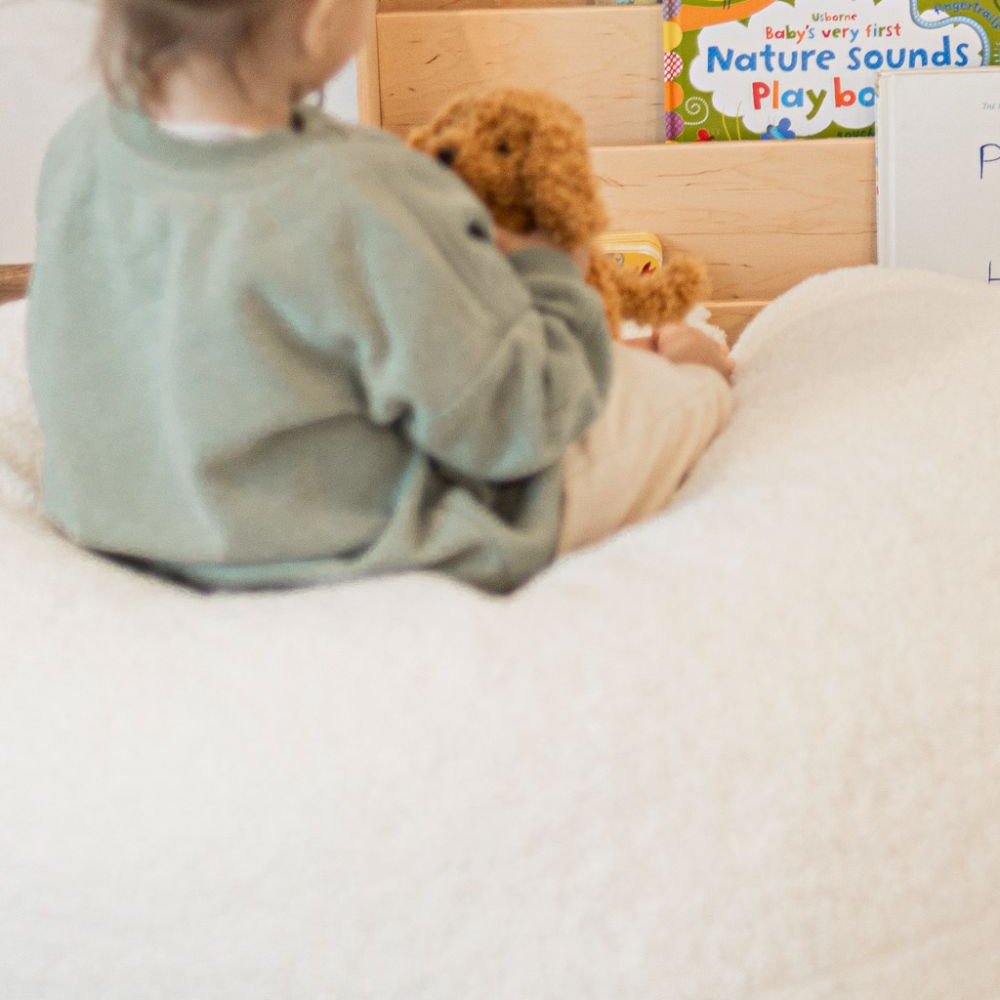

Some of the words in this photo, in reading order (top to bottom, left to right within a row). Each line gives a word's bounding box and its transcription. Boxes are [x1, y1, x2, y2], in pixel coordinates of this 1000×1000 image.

[811, 12, 857, 22] Usborne
[933, 1, 1000, 29] fingertrails
[765, 25, 815, 44] Baby's
[821, 26, 859, 43] very
[866, 23, 902, 38] first
[706, 44, 836, 73] Nature
